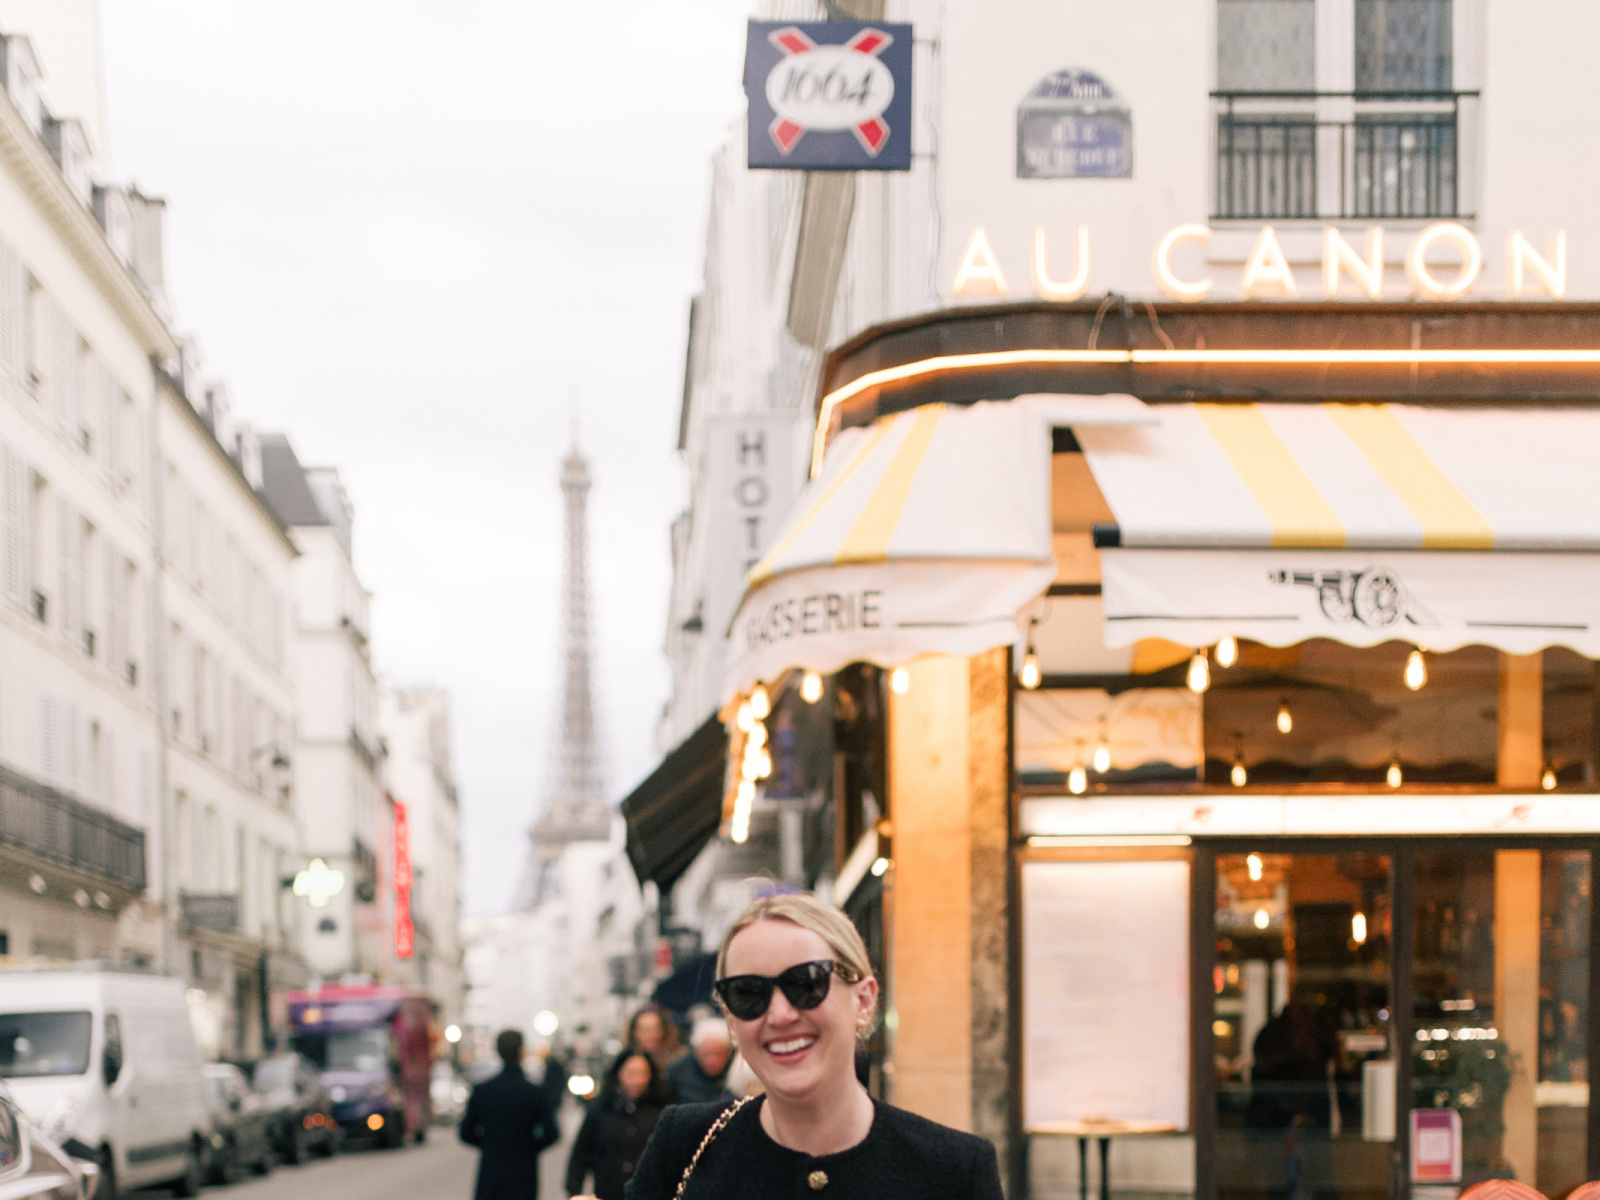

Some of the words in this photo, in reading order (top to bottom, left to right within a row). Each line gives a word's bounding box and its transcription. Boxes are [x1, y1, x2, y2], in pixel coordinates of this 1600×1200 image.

[782, 59, 876, 107] 1664
[952, 224, 1093, 302] AU
[1154, 223, 1567, 302] CANON
[736, 430, 768, 573] HOT
